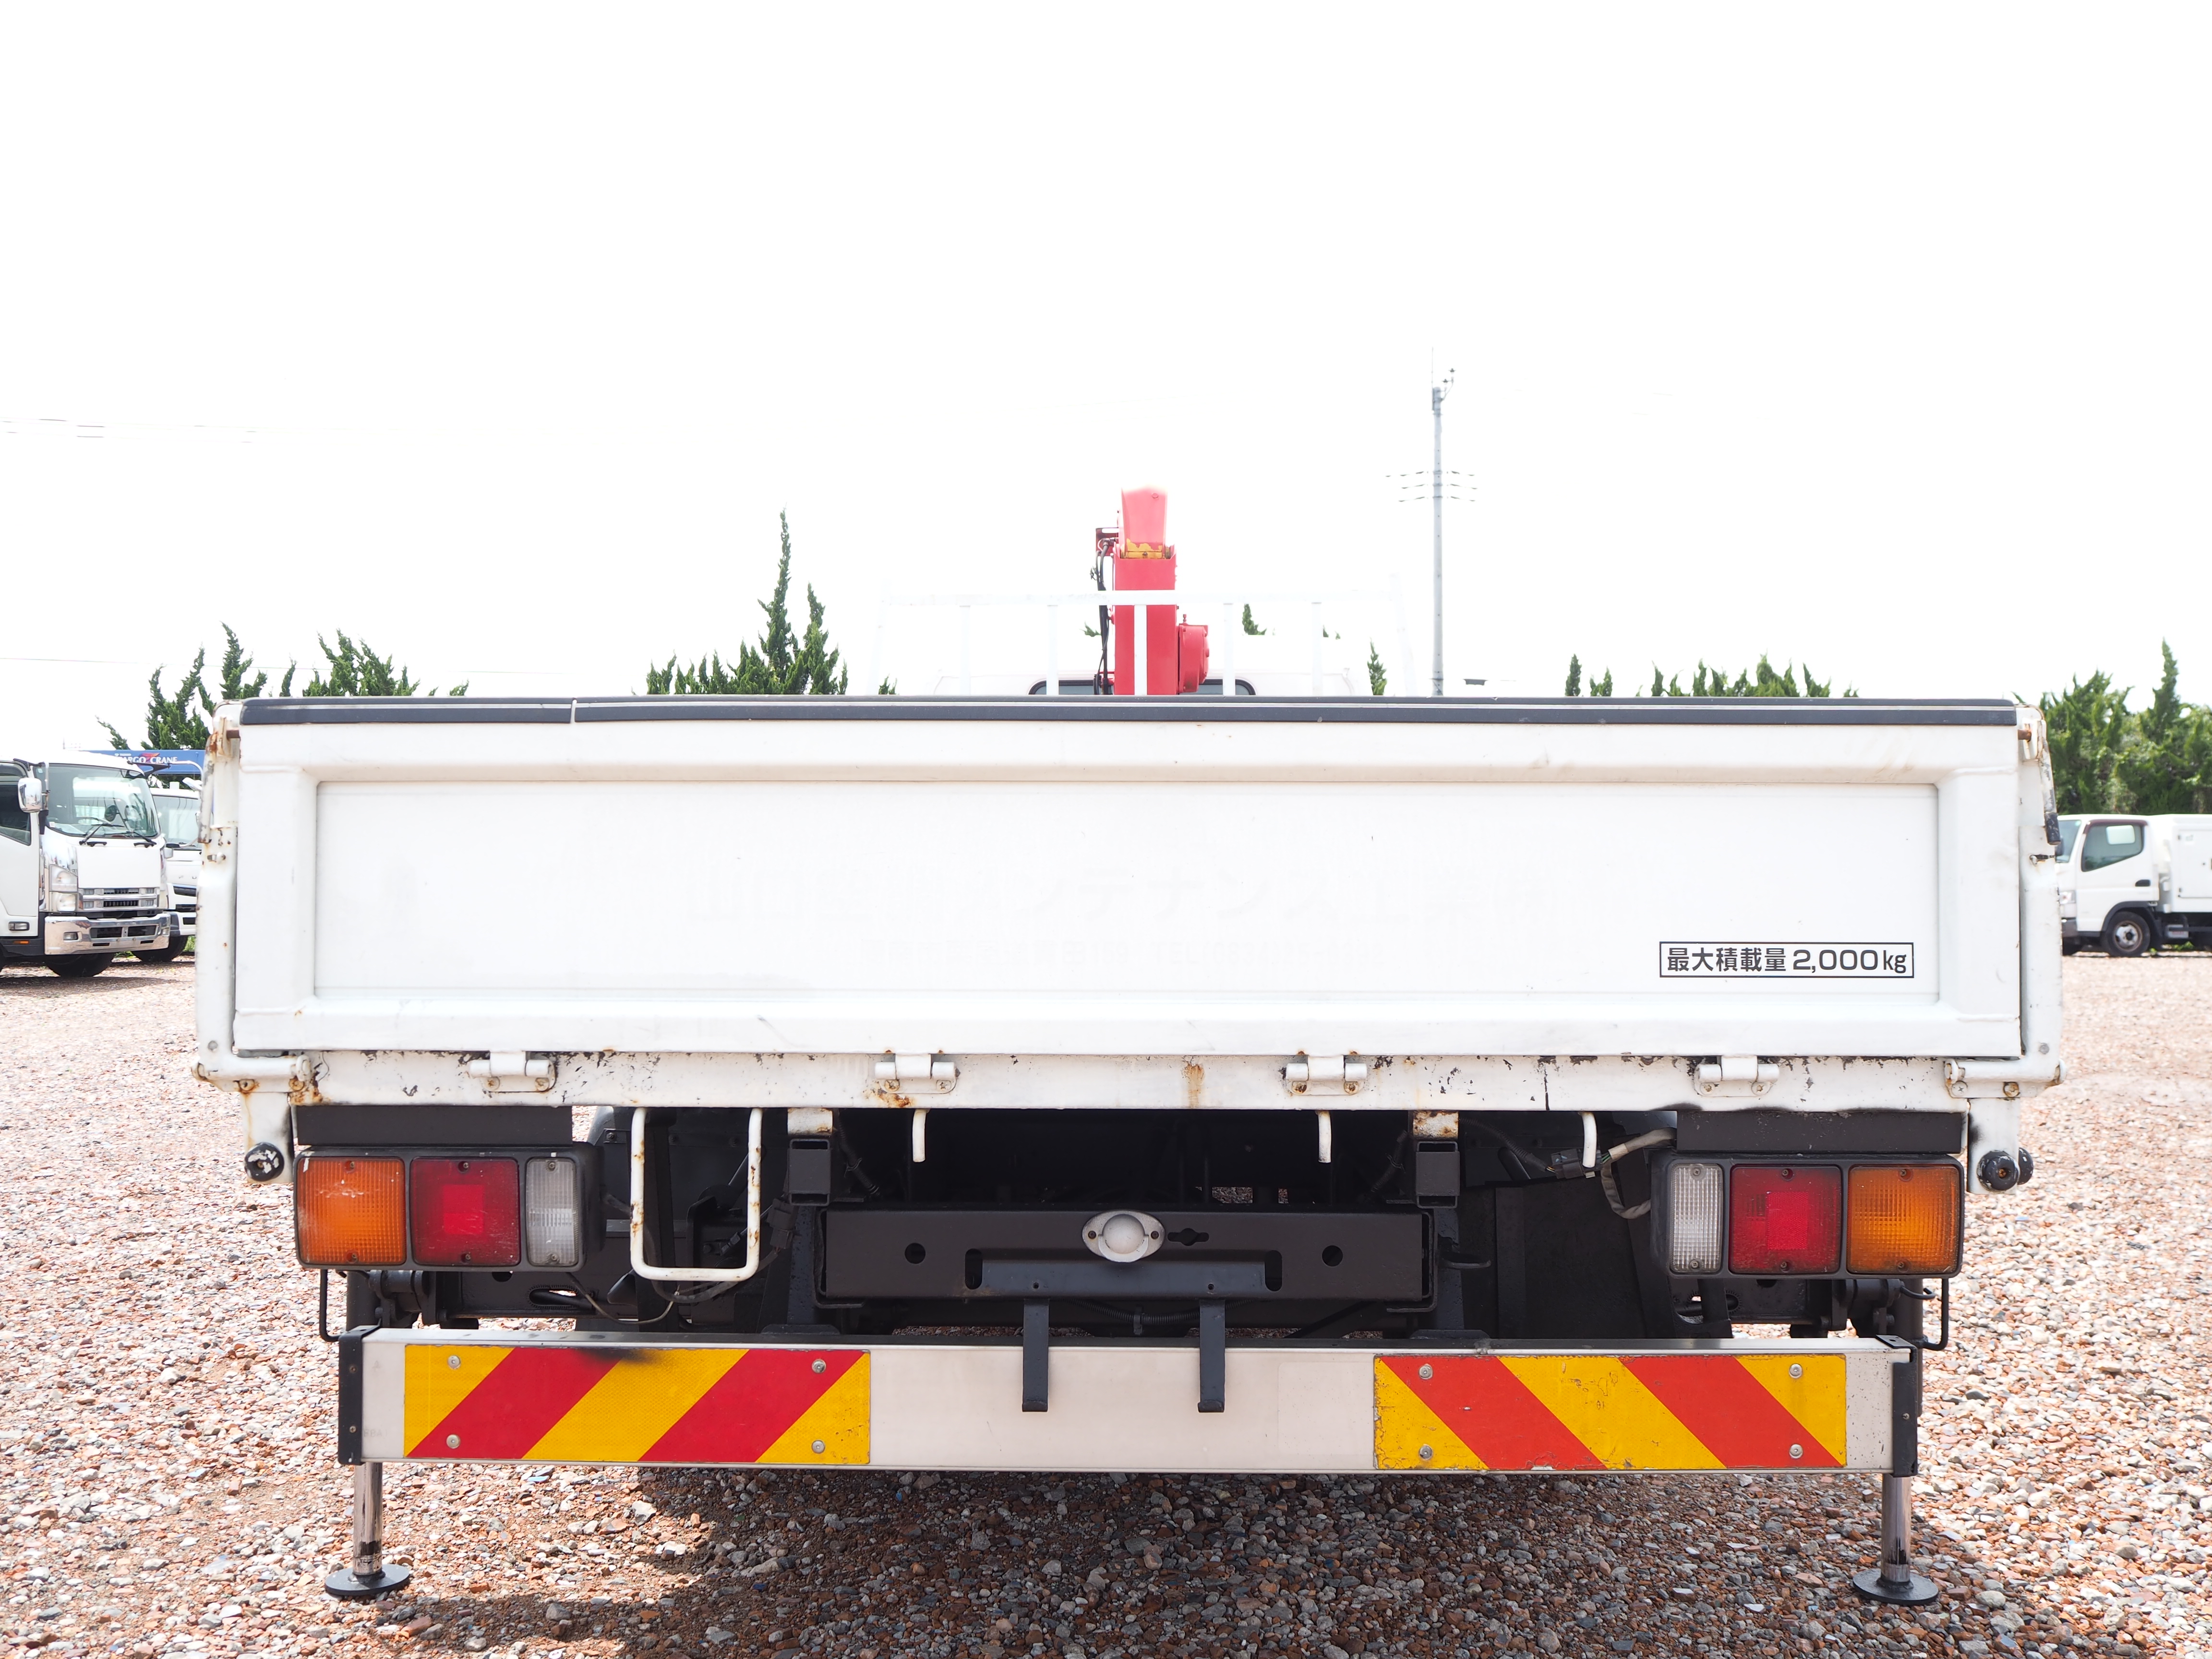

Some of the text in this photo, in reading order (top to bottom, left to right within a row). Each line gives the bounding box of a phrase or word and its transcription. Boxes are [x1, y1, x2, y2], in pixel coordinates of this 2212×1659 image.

[1667, 947, 1907, 974] 最大積載量 2,000kg
